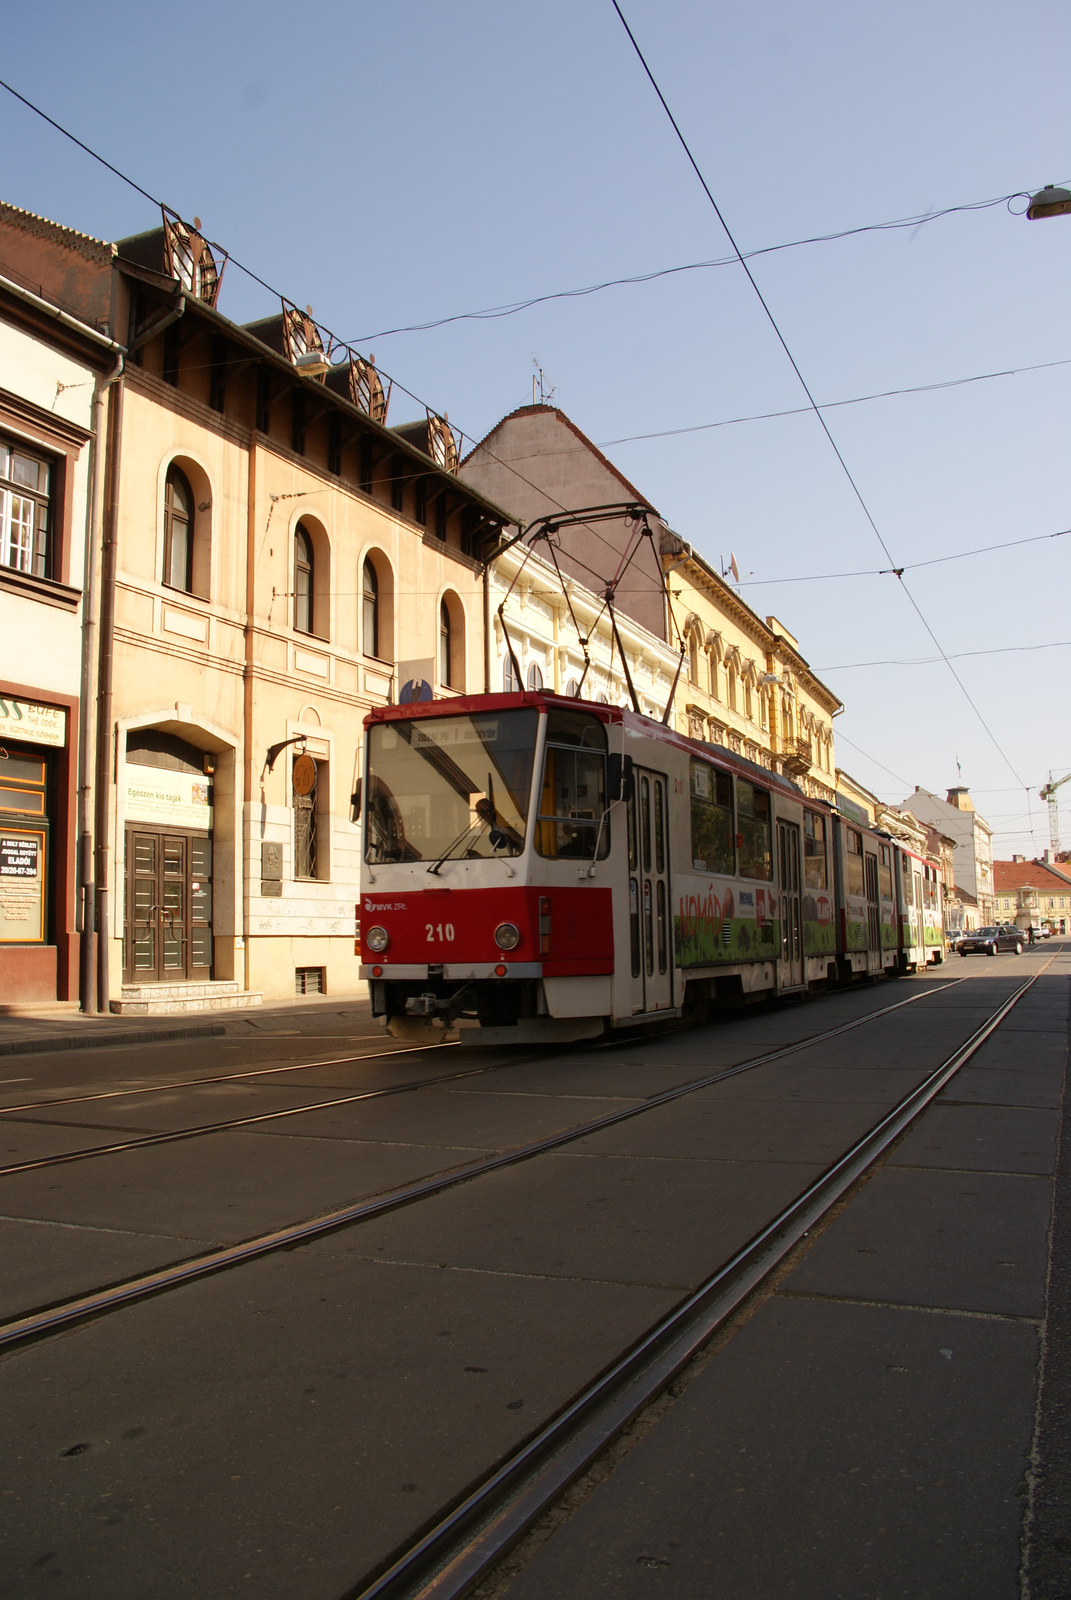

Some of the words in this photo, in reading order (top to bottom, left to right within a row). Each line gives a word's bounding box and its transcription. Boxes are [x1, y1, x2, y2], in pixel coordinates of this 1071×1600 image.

[28, 715, 39, 725] THE
[128, 787, 155, 798] Egészen
[155, 791, 165, 801] kis
[166, 793, 182, 804] tájak
[8, 856, 31, 865] ELADÓ!
[376, 903, 393, 911] MVK
[679, 883, 723, 939] NOMÁD
[425, 923, 455, 942] 210
